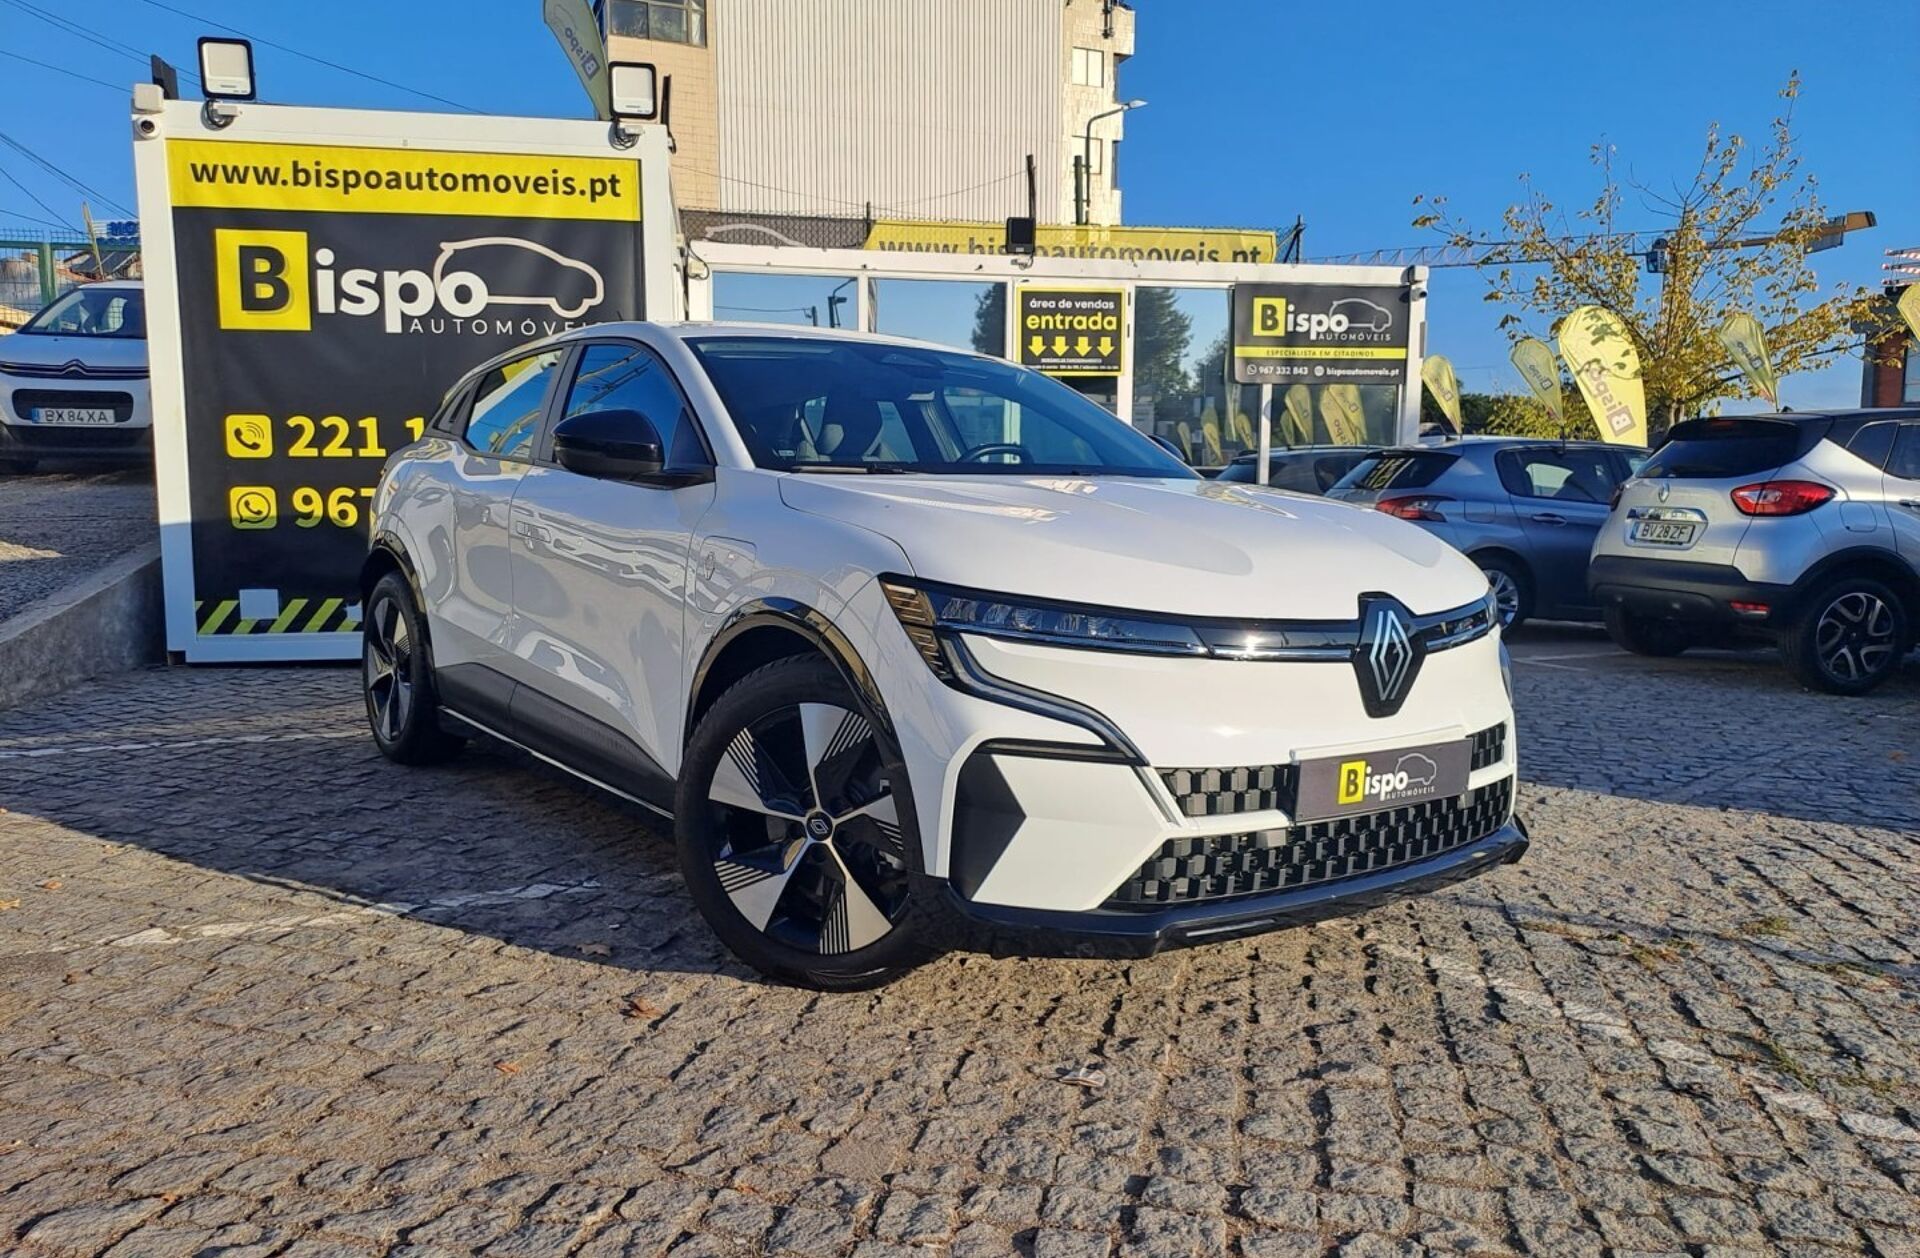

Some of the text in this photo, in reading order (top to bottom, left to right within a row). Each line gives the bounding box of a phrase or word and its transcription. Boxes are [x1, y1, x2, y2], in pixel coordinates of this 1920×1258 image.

[190, 160, 622, 202] www.bispoautomoveis.pt
[238, 244, 489, 333] Bispo
[1029, 298, 1115, 309] área de vendas
[409, 318, 604, 336] AUTOMÓVE
[1026, 311, 1118, 331] entrada
[1260, 304, 1350, 341] Bispo
[1318, 332, 1392, 342] AUTOMÓVEIS
[1258, 366, 1274, 375] 967
[1326, 366, 1400, 377] bispoautomoveis.pt
[286, 415, 387, 457] 221
[1345, 765, 1409, 801] Bispo
[1386, 785, 1436, 800] AUTOMÓVEIS
